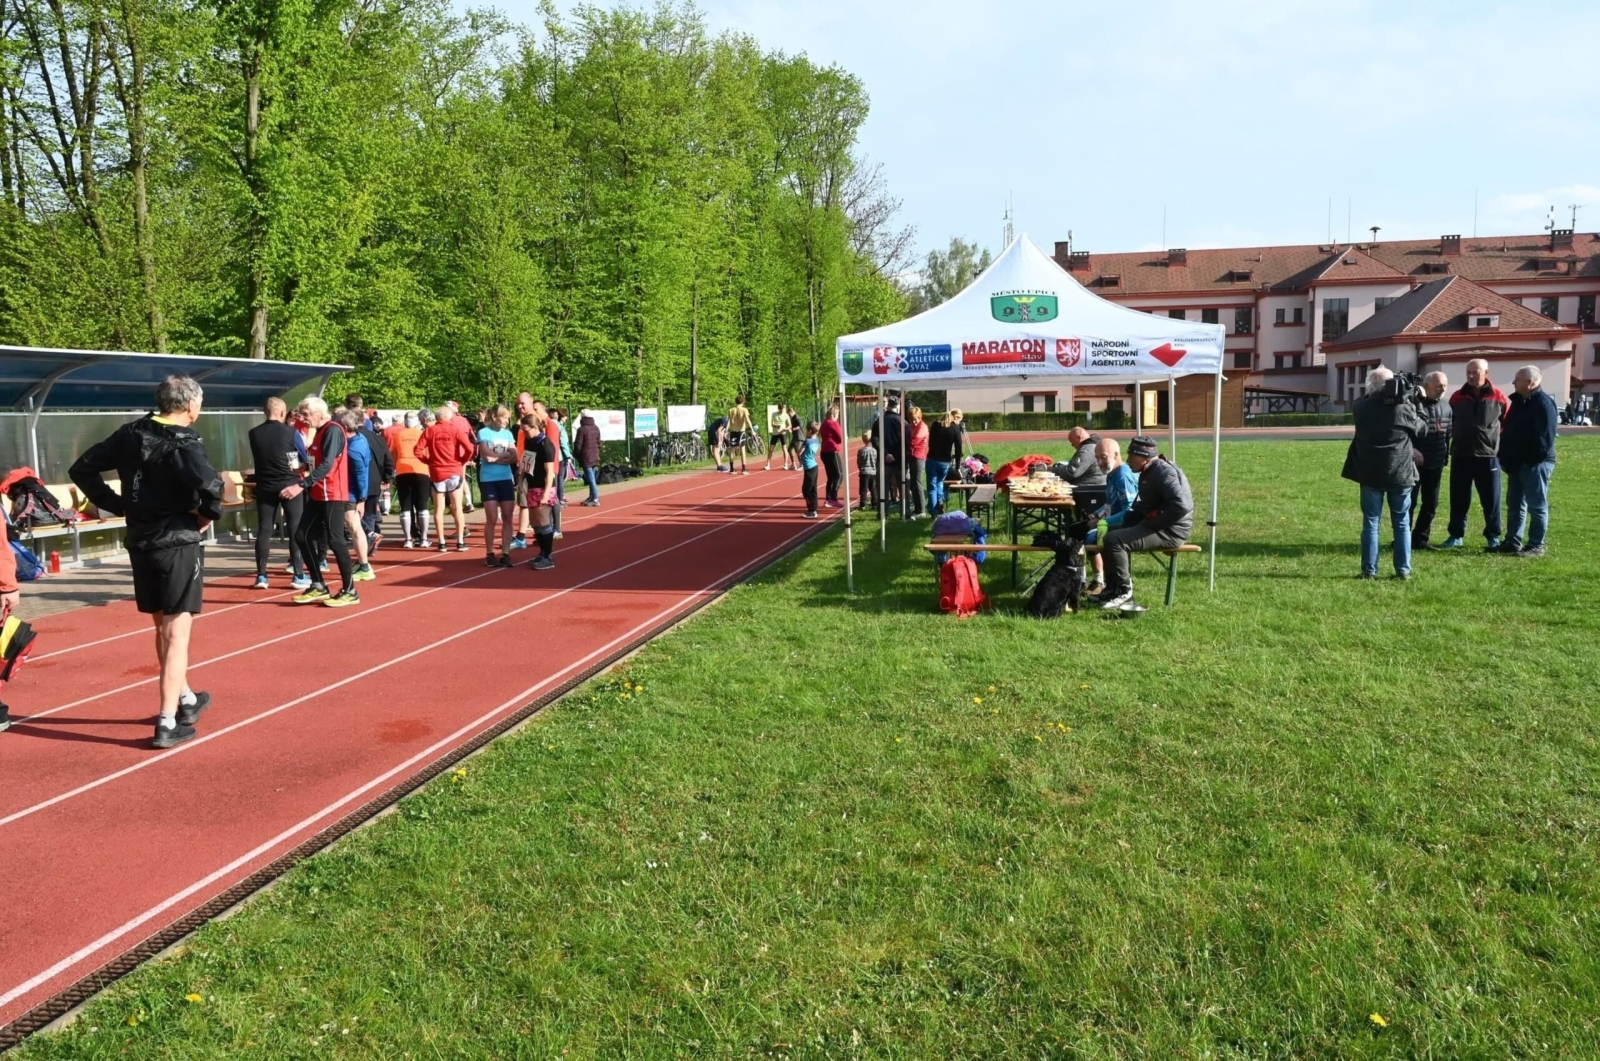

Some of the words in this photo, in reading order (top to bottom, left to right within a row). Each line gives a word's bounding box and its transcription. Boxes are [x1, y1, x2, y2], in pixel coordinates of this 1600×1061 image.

[962, 339, 1045, 355] MARATON
[1091, 338, 1130, 348] NÁRODNÍ
[909, 347, 933, 355] ČESKÝ
[1091, 348, 1139, 357] SPORTOVNÍ
[909, 352, 950, 363] ATLETICKÝ
[1091, 359, 1136, 367] AGENTURA
